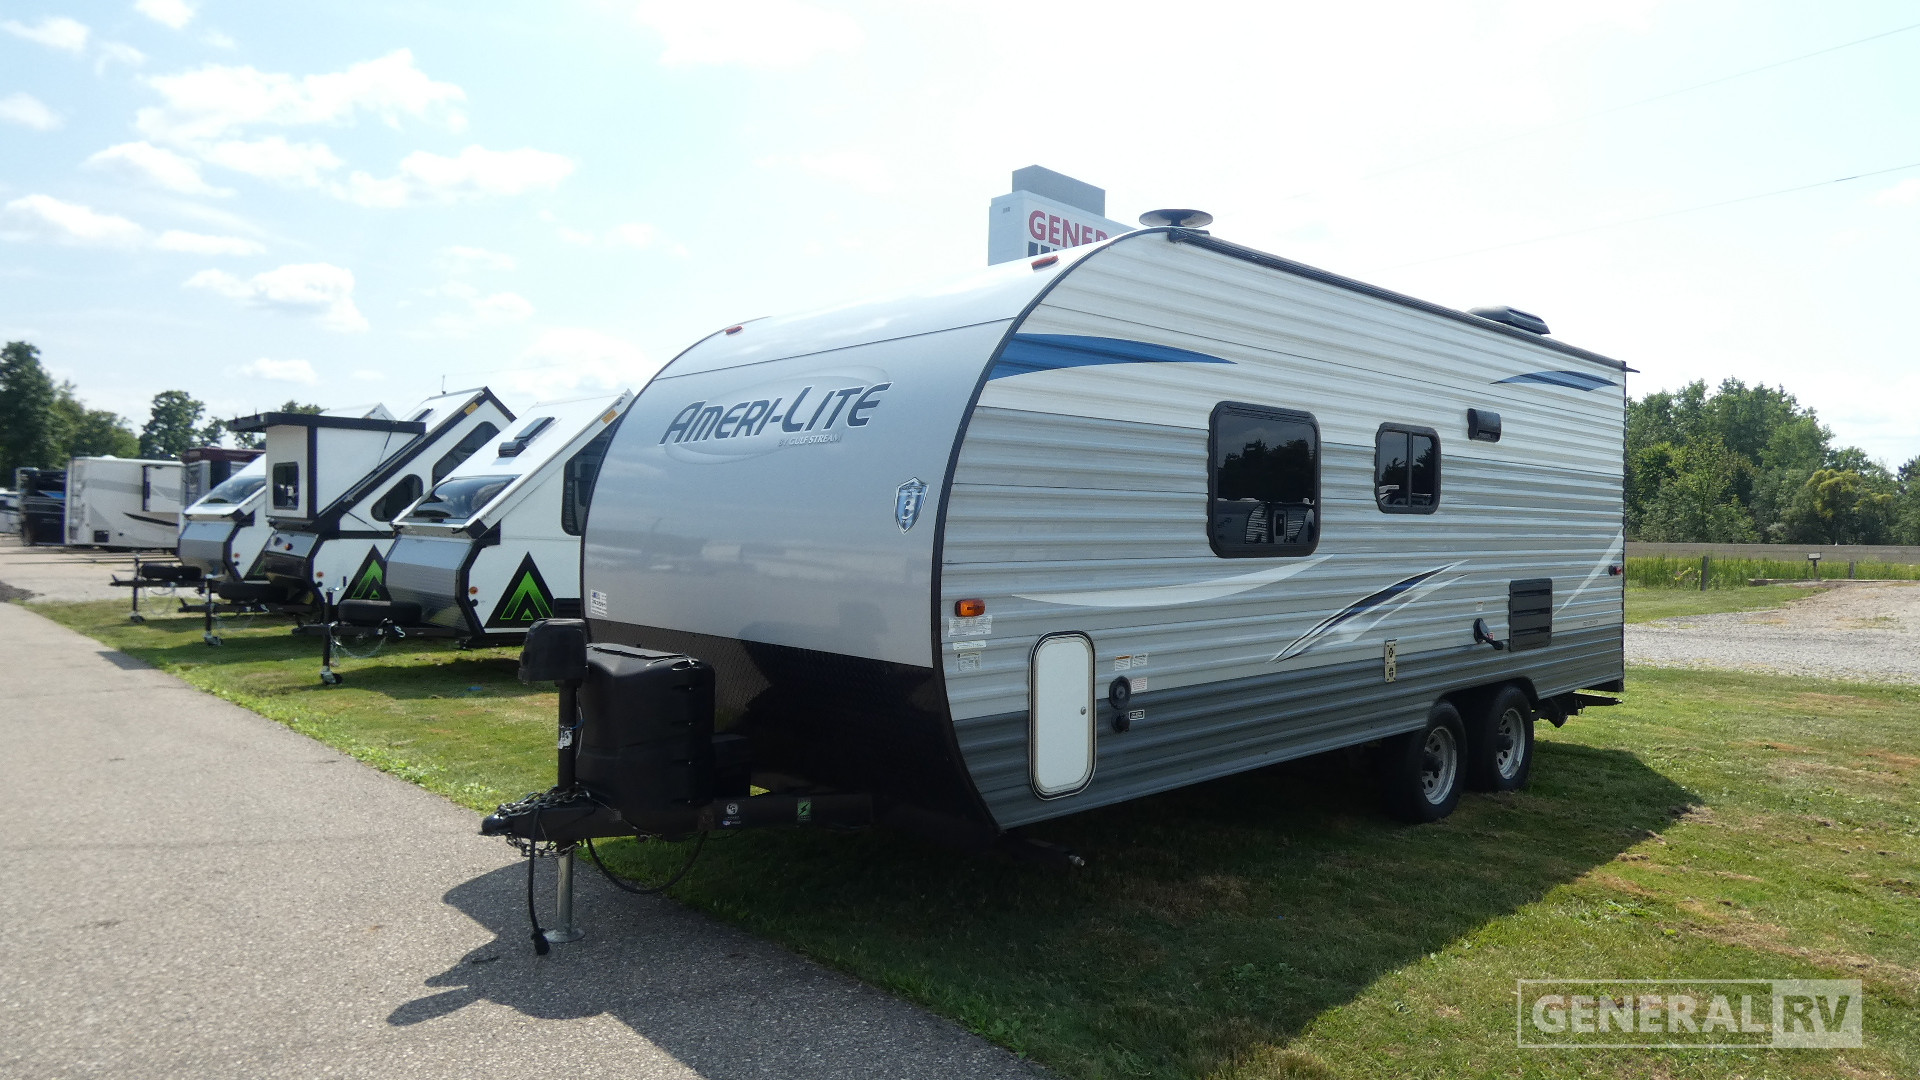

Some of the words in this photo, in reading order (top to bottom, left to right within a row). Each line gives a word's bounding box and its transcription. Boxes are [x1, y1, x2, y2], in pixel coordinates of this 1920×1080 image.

[658, 382, 893, 445] AMERI-LITE
[789, 436, 809, 446] GULF
[808, 433, 841, 444] STREAM
